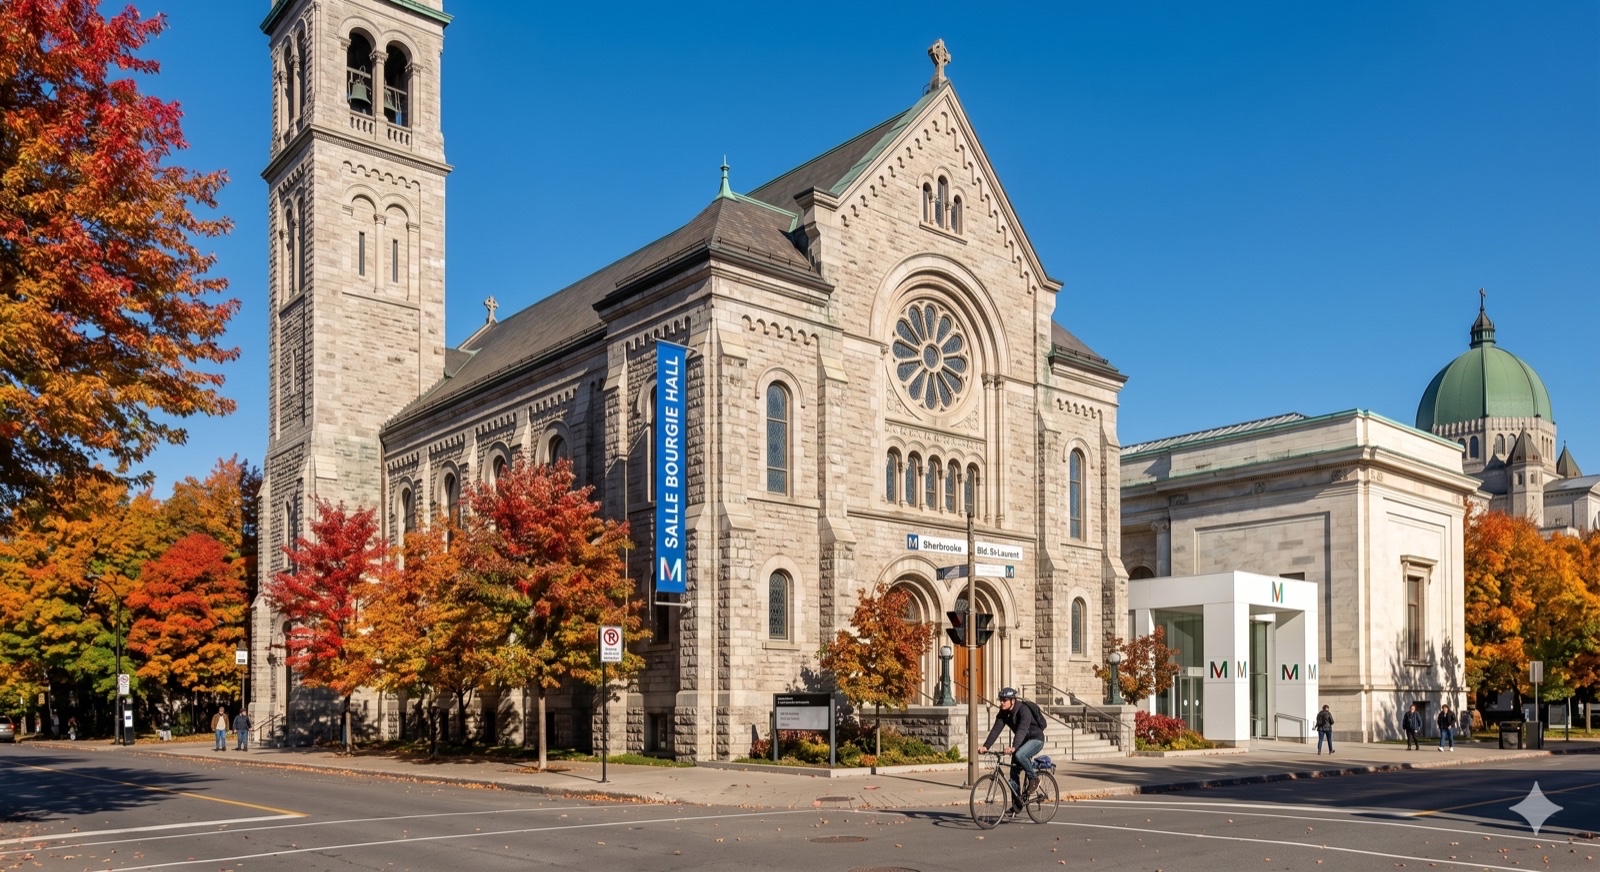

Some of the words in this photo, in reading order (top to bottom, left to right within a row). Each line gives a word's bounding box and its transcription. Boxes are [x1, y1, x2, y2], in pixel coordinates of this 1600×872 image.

[665, 355, 679, 402] HALL
[665, 406, 679, 488] BOURGIE
[665, 493, 679, 549] SALLE
[908, 536, 918, 549] M
[923, 540, 962, 552] Sherbrooke
[977, 546, 989, 555] Bld.
[660, 556, 682, 583] M
[1271, 581, 1283, 603] M
[1210, 660, 1228, 679] M
[1237, 660, 1247, 679] M
[1281, 663, 1299, 681] M
[1308, 664, 1317, 680] M
